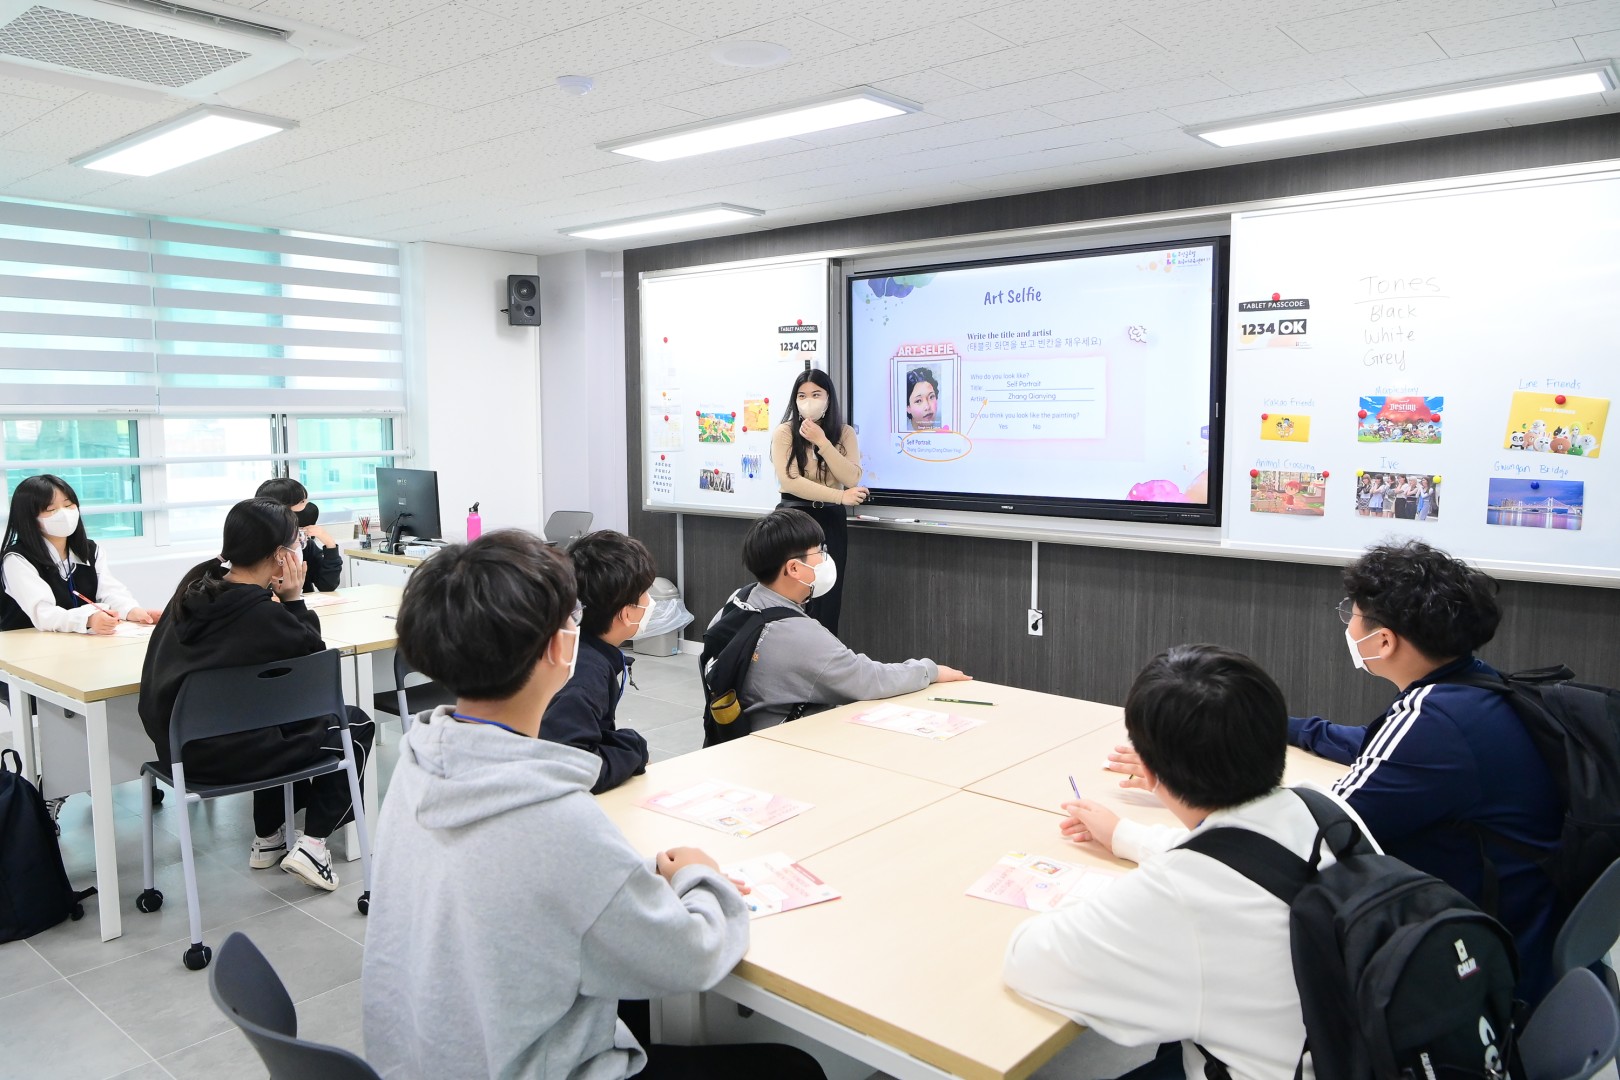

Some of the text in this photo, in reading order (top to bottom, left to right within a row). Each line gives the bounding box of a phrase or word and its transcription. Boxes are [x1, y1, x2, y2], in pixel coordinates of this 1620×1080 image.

[1360, 275, 1441, 296] Tones
[983, 286, 1042, 306] Art Selfie
[1267, 300, 1306, 308] PASSCODE:
[1370, 304, 1417, 323] Black
[1241, 320, 1306, 336] 1234 OK
[967, 329, 1052, 340] Write the title and artist
[1364, 325, 1416, 345] White
[780, 340, 816, 351] 1234 OK
[1020, 339, 1035, 349] 보고
[1038, 338, 1062, 349] 빈칸을
[897, 343, 954, 357] ART SELFIE
[1363, 348, 1406, 372] Grey
[992, 373, 1002, 381] you
[1006, 380, 1041, 388] Self Portrait
[1518, 378, 1581, 390] Line Friends
[1008, 392, 1057, 401] Zhang Qianying
[1388, 402, 1417, 413] Destiny
[1051, 412, 1080, 420] painting?
[1255, 458, 1316, 471] Animal Crossing
[1379, 456, 1400, 470] Ive
